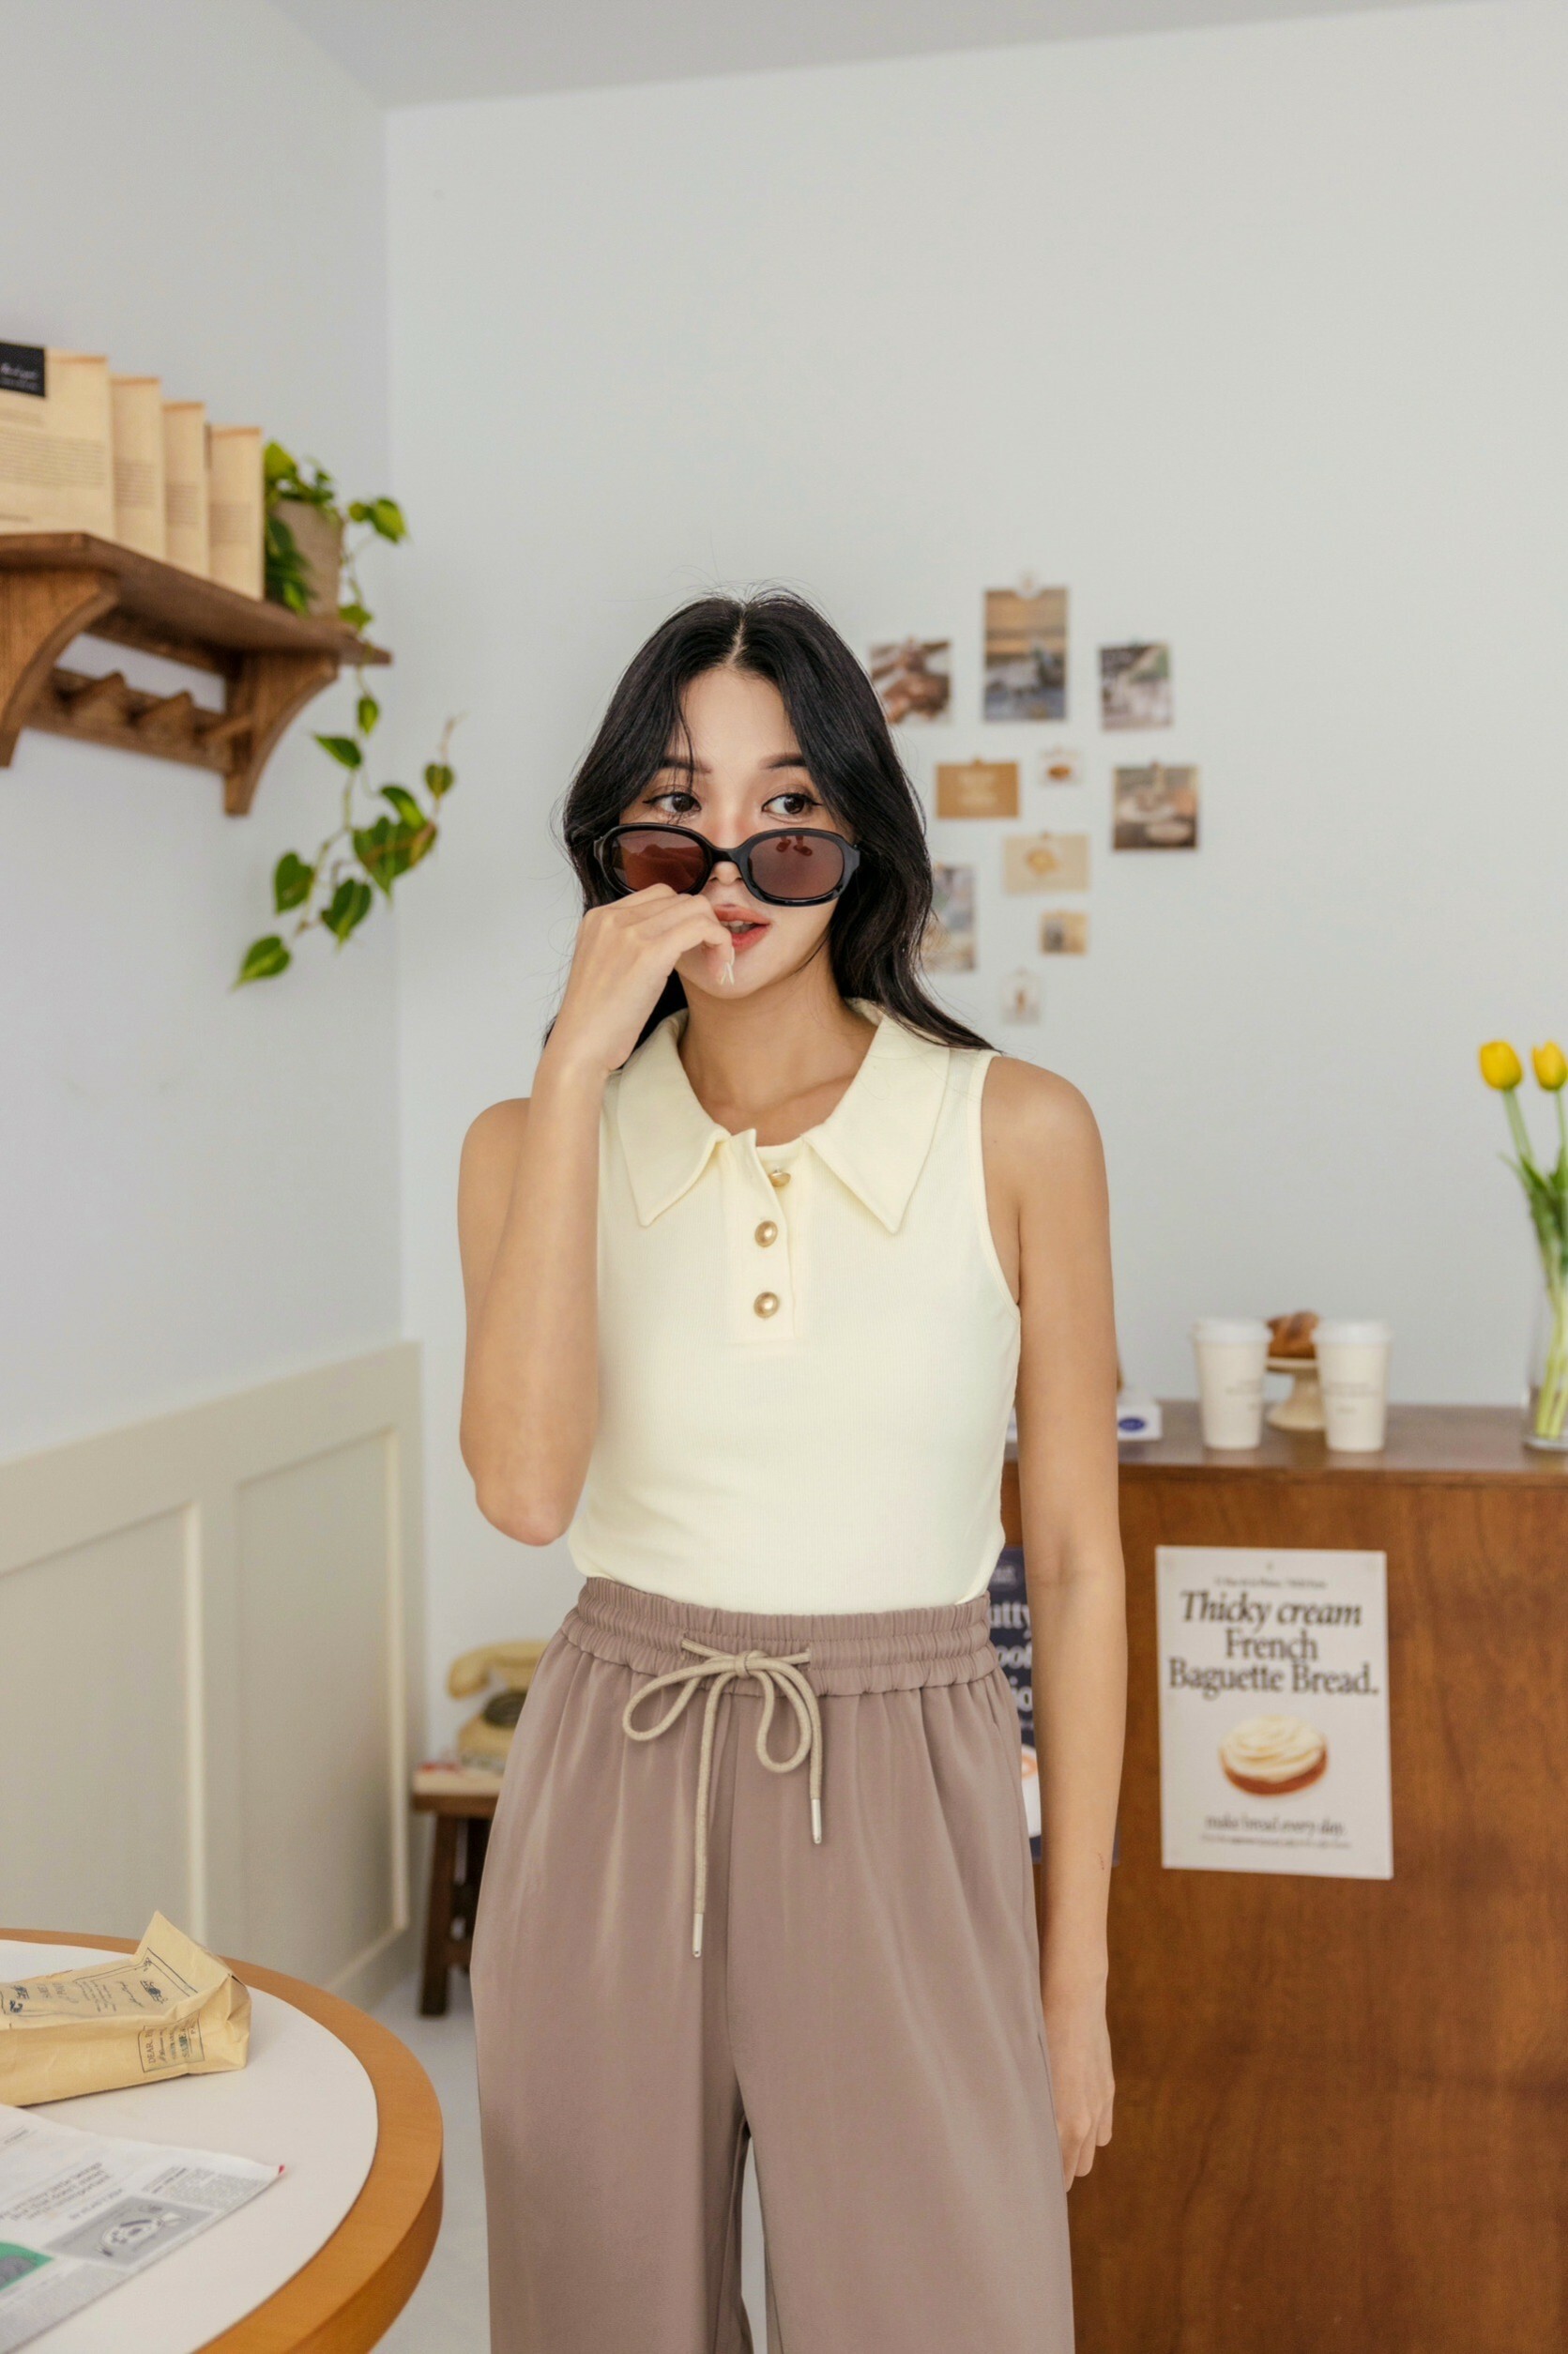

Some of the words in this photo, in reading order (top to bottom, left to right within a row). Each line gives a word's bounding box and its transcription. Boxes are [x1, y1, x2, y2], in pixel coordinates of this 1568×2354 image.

[1180, 1589, 1272, 1634] Thicky
[1275, 1601, 1362, 1627] cream
[1225, 1628, 1319, 1660] French
[1168, 1657, 1285, 1701] Baguette
[1291, 1660, 1380, 1695] Bread.
